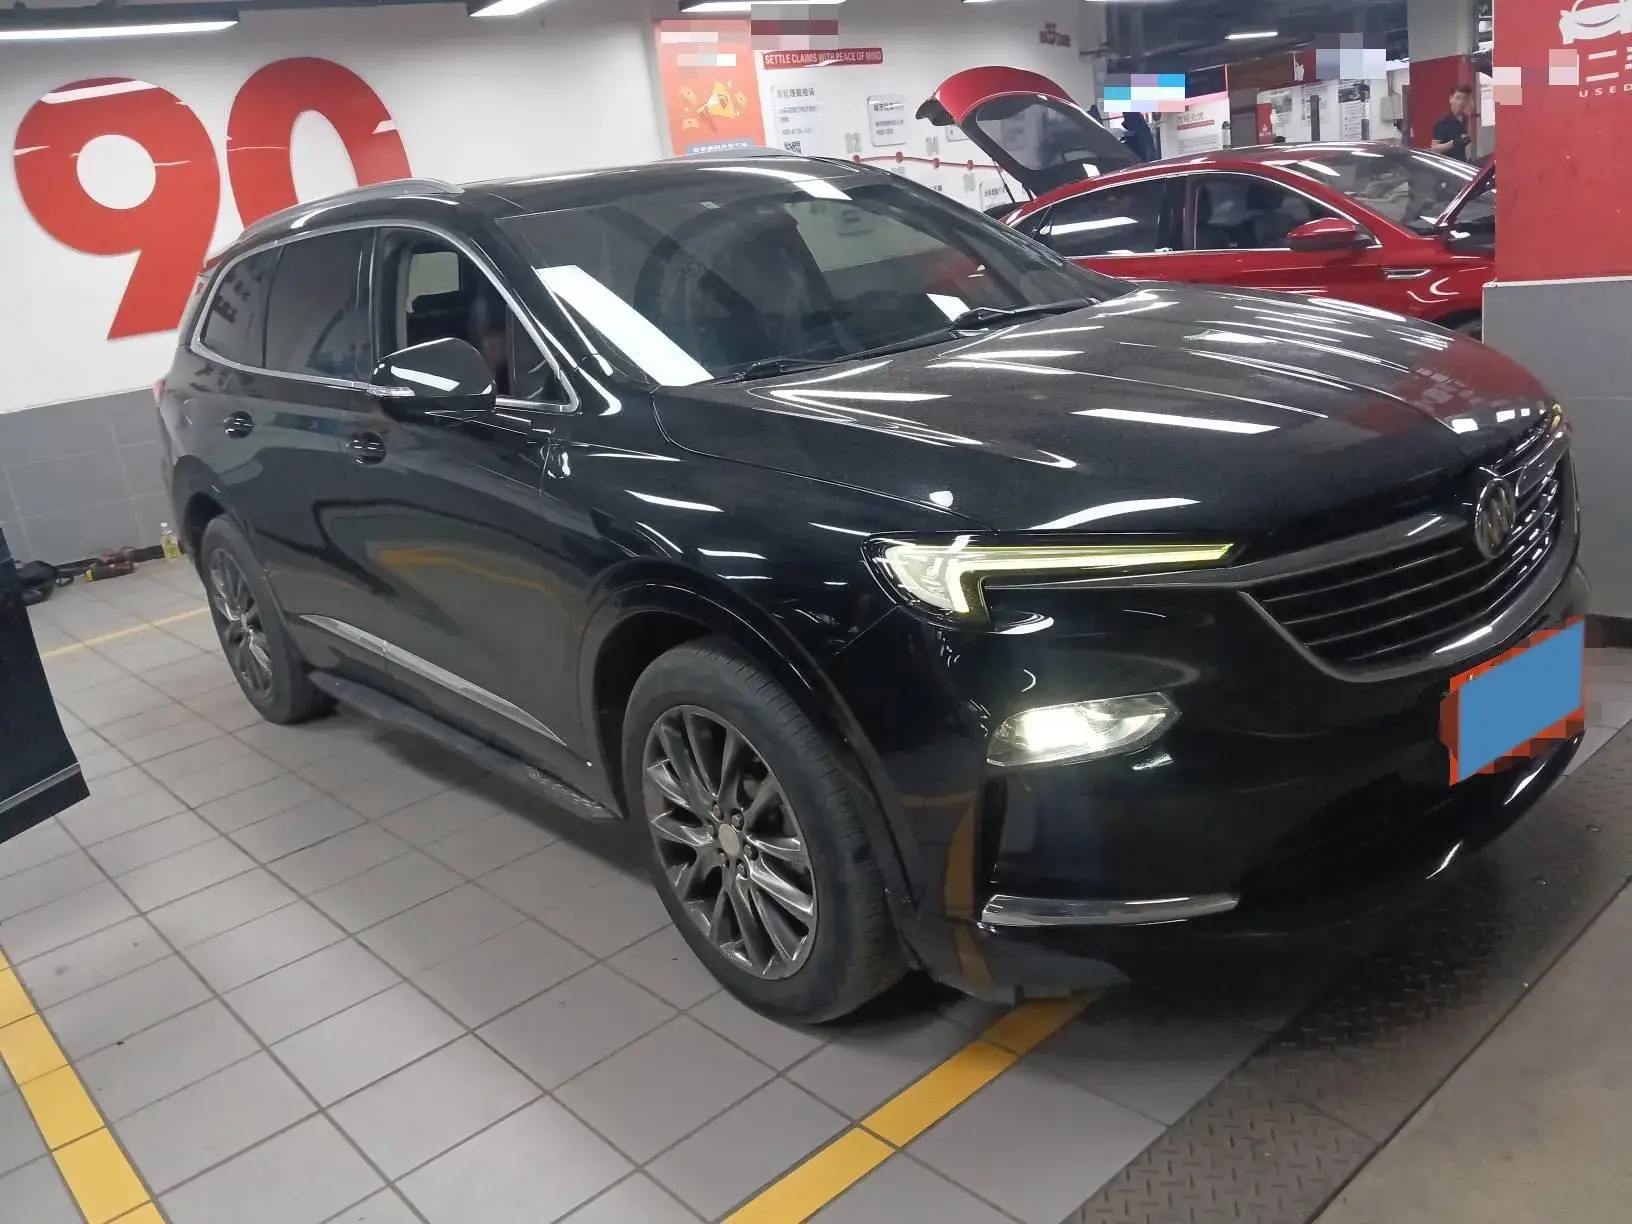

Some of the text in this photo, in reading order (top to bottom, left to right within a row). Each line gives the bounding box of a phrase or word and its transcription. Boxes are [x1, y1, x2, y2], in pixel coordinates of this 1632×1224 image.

[764, 50, 882, 64] SETTLE CLAIMS WITH PEACE OF MIND
[13, 56, 414, 341] 90
